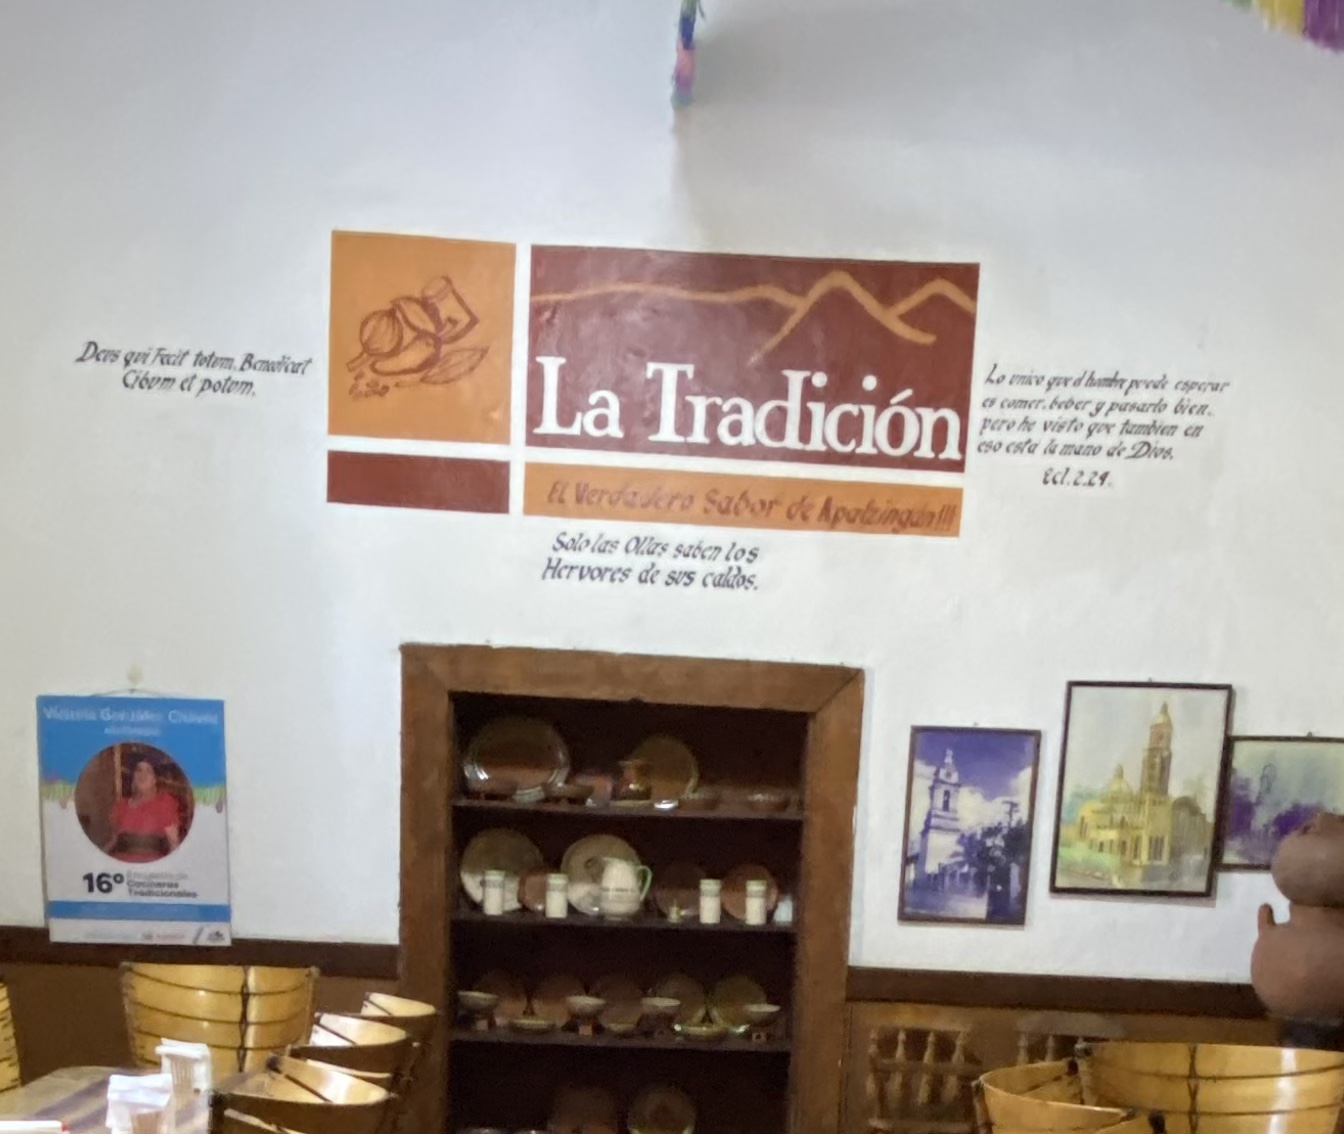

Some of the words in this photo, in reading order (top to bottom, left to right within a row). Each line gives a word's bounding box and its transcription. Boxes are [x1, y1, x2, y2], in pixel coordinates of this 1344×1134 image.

[123, 347, 152, 369] qui
[122, 369, 177, 391] Cibum
[179, 374, 197, 392] et
[985, 363, 1007, 385] Lo
[1045, 375, 1073, 393] que
[1084, 370, 1127, 389] hombre
[1124, 373, 1169, 396] puede
[1174, 380, 1230, 394] esperar
[533, 356, 625, 439] La
[646, 362, 963, 461] Tradición
[982, 397, 997, 408] es
[1048, 396, 1092, 411] beber
[1089, 400, 1106, 417] y
[1104, 398, 1168, 417] pasarlo
[979, 417, 1017, 436] pero
[1017, 416, 1036, 433] he
[1043, 416, 1084, 433] visto
[1086, 421, 1116, 439] que
[1184, 424, 1205, 438] en
[977, 440, 1003, 454] eso
[1043, 438, 1059, 455] la
[1058, 443, 1103, 456] mano
[1106, 441, 1127, 457] de
[575, 481, 695, 512] Verdadero
[702, 486, 781, 518] Sabor
[786, 494, 816, 522] de
[552, 531, 591, 552] Solo
[590, 532, 620, 554] las
[624, 535, 669, 557] Ollas
[672, 540, 722, 562] saben
[724, 541, 760, 564] los
[541, 556, 632, 583] Hervores
[637, 561, 660, 585] de
[663, 569, 696, 587] sus
